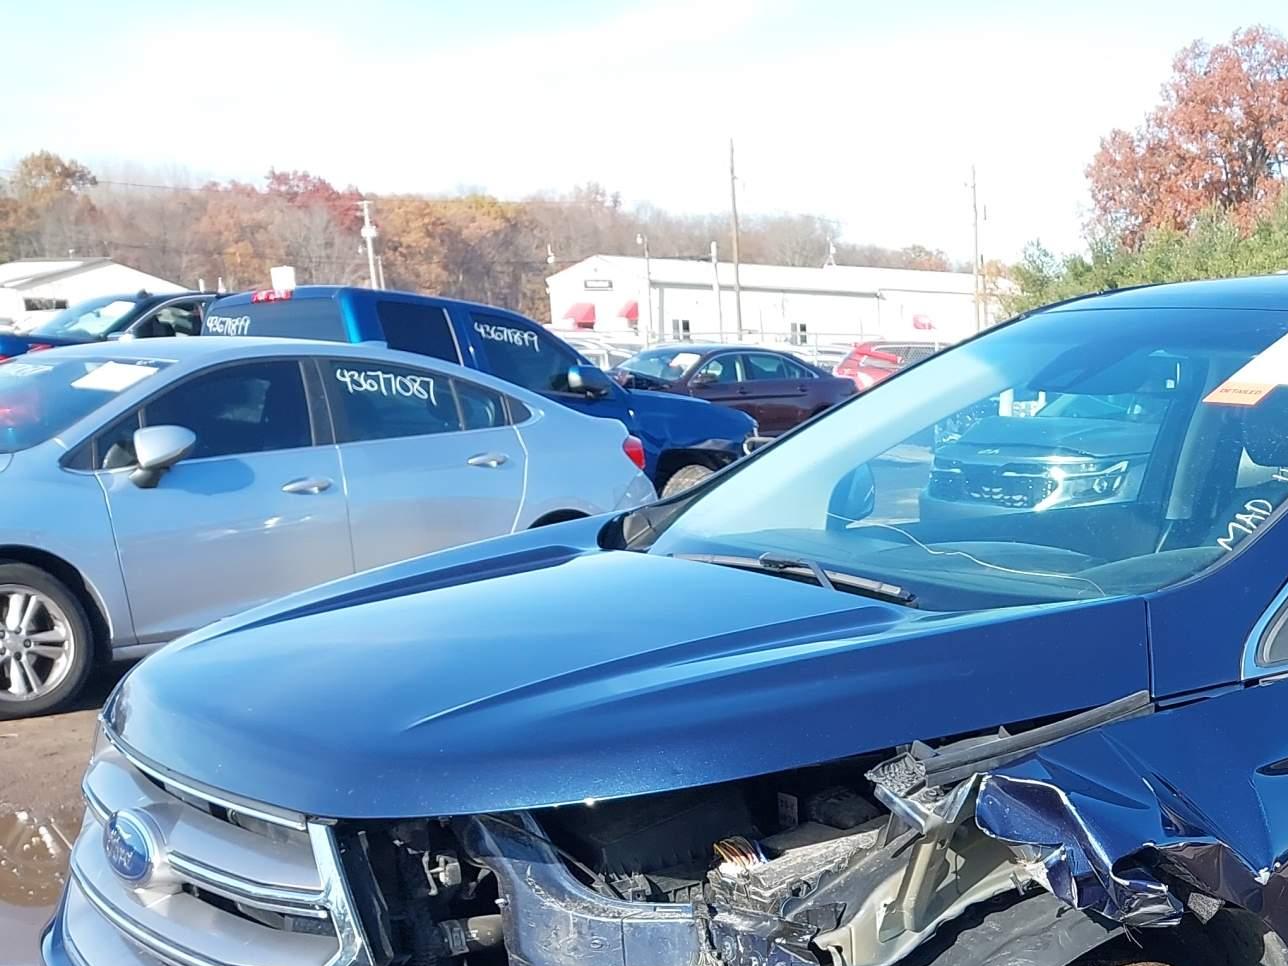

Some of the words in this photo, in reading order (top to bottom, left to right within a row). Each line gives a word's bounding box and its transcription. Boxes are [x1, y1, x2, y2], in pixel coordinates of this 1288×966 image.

[474, 321, 540, 352] 43671899
[336, 368, 437, 406] 43677087
[1217, 499, 1272, 551] MAD
